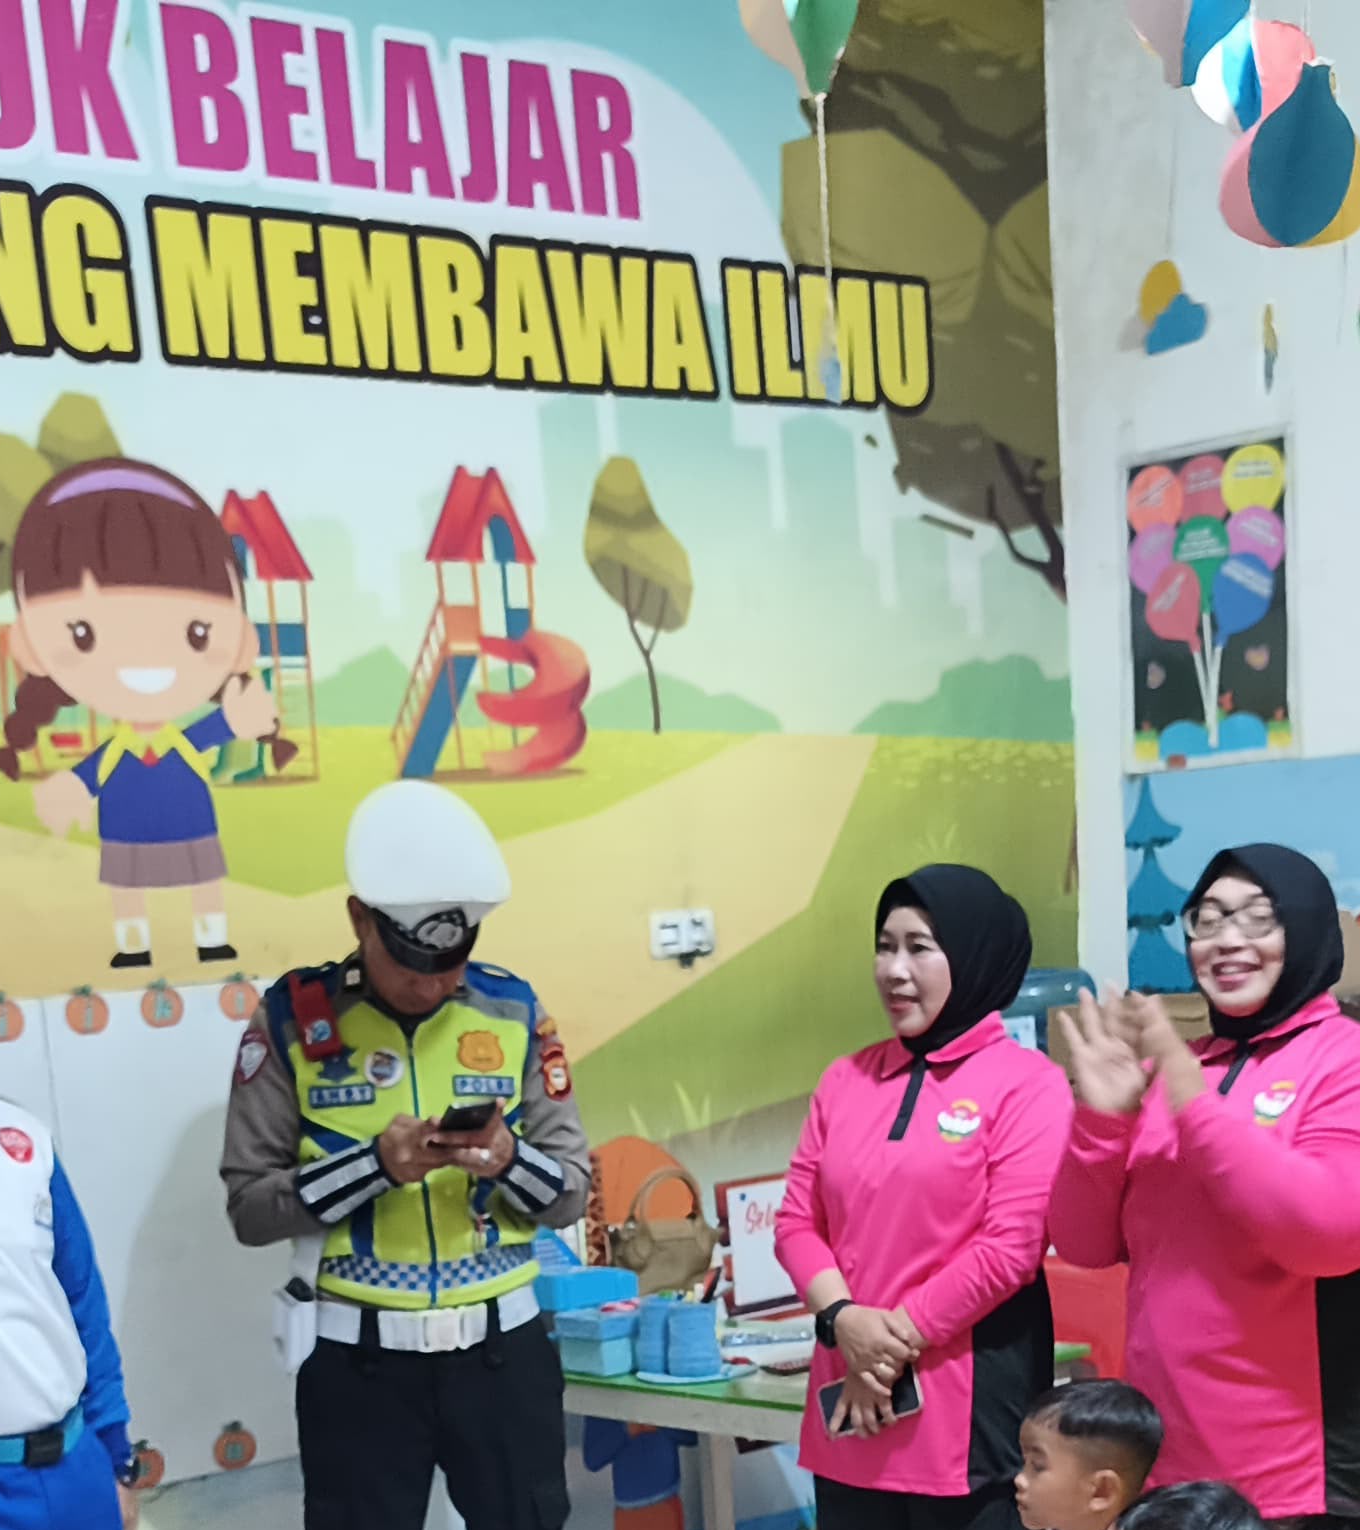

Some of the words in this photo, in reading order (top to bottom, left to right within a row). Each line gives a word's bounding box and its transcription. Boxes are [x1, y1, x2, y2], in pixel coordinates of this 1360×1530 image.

[159, 2, 642, 221] BELAJAR
[149, 198, 719, 398] MEMBAWA
[723, 261, 931, 412] ILMU
